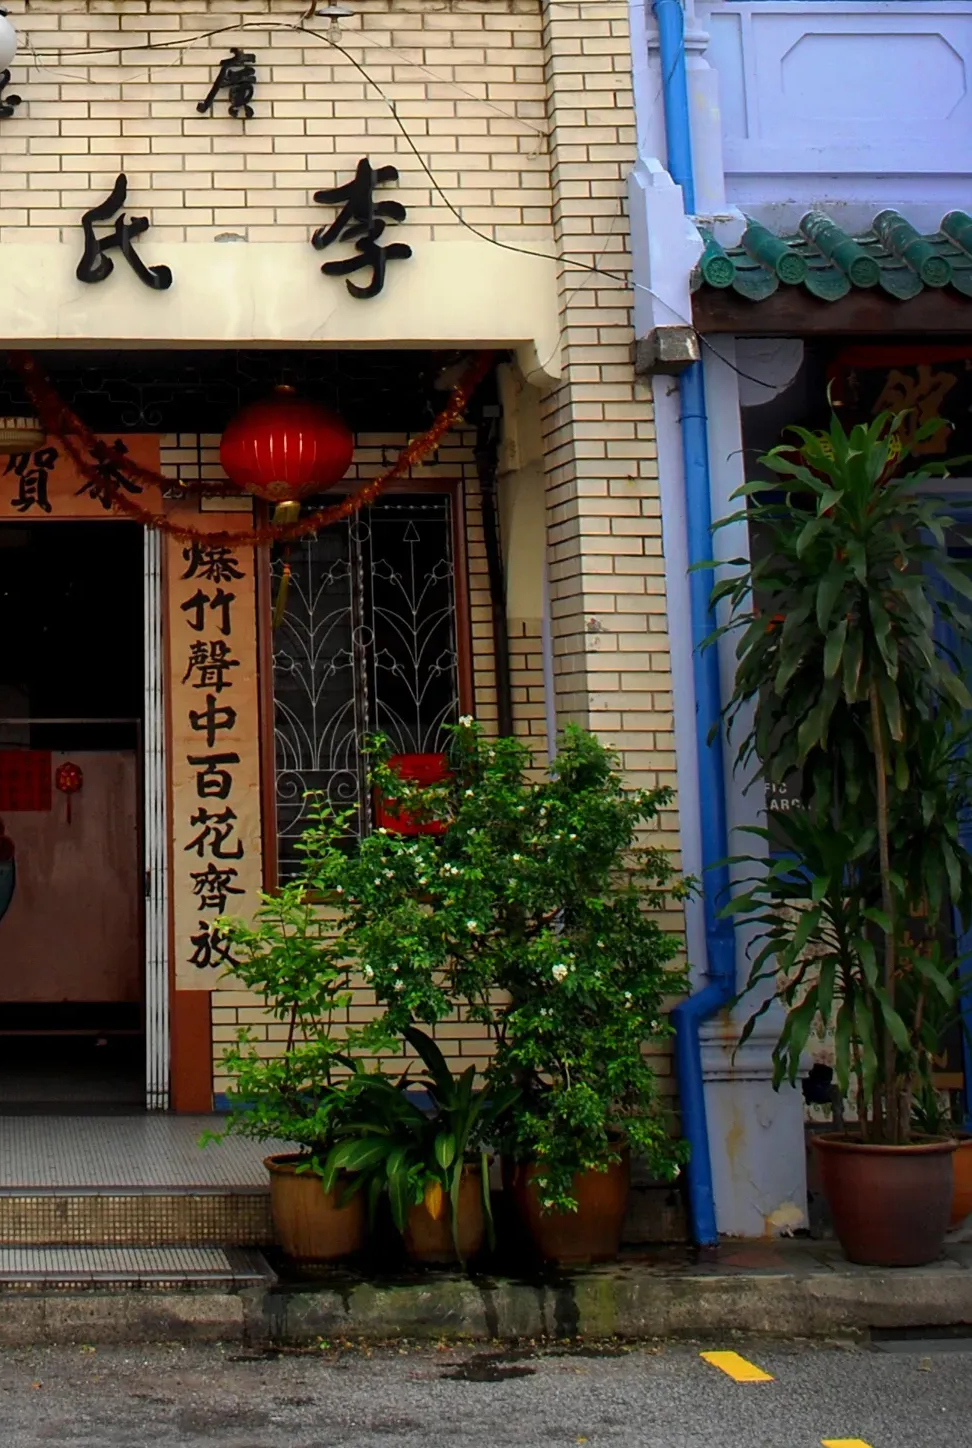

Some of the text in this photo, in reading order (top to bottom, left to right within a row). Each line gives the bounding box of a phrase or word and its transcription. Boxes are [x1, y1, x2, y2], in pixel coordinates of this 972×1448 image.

[180, 536, 246, 970] 爆竹聲中百花齊放
